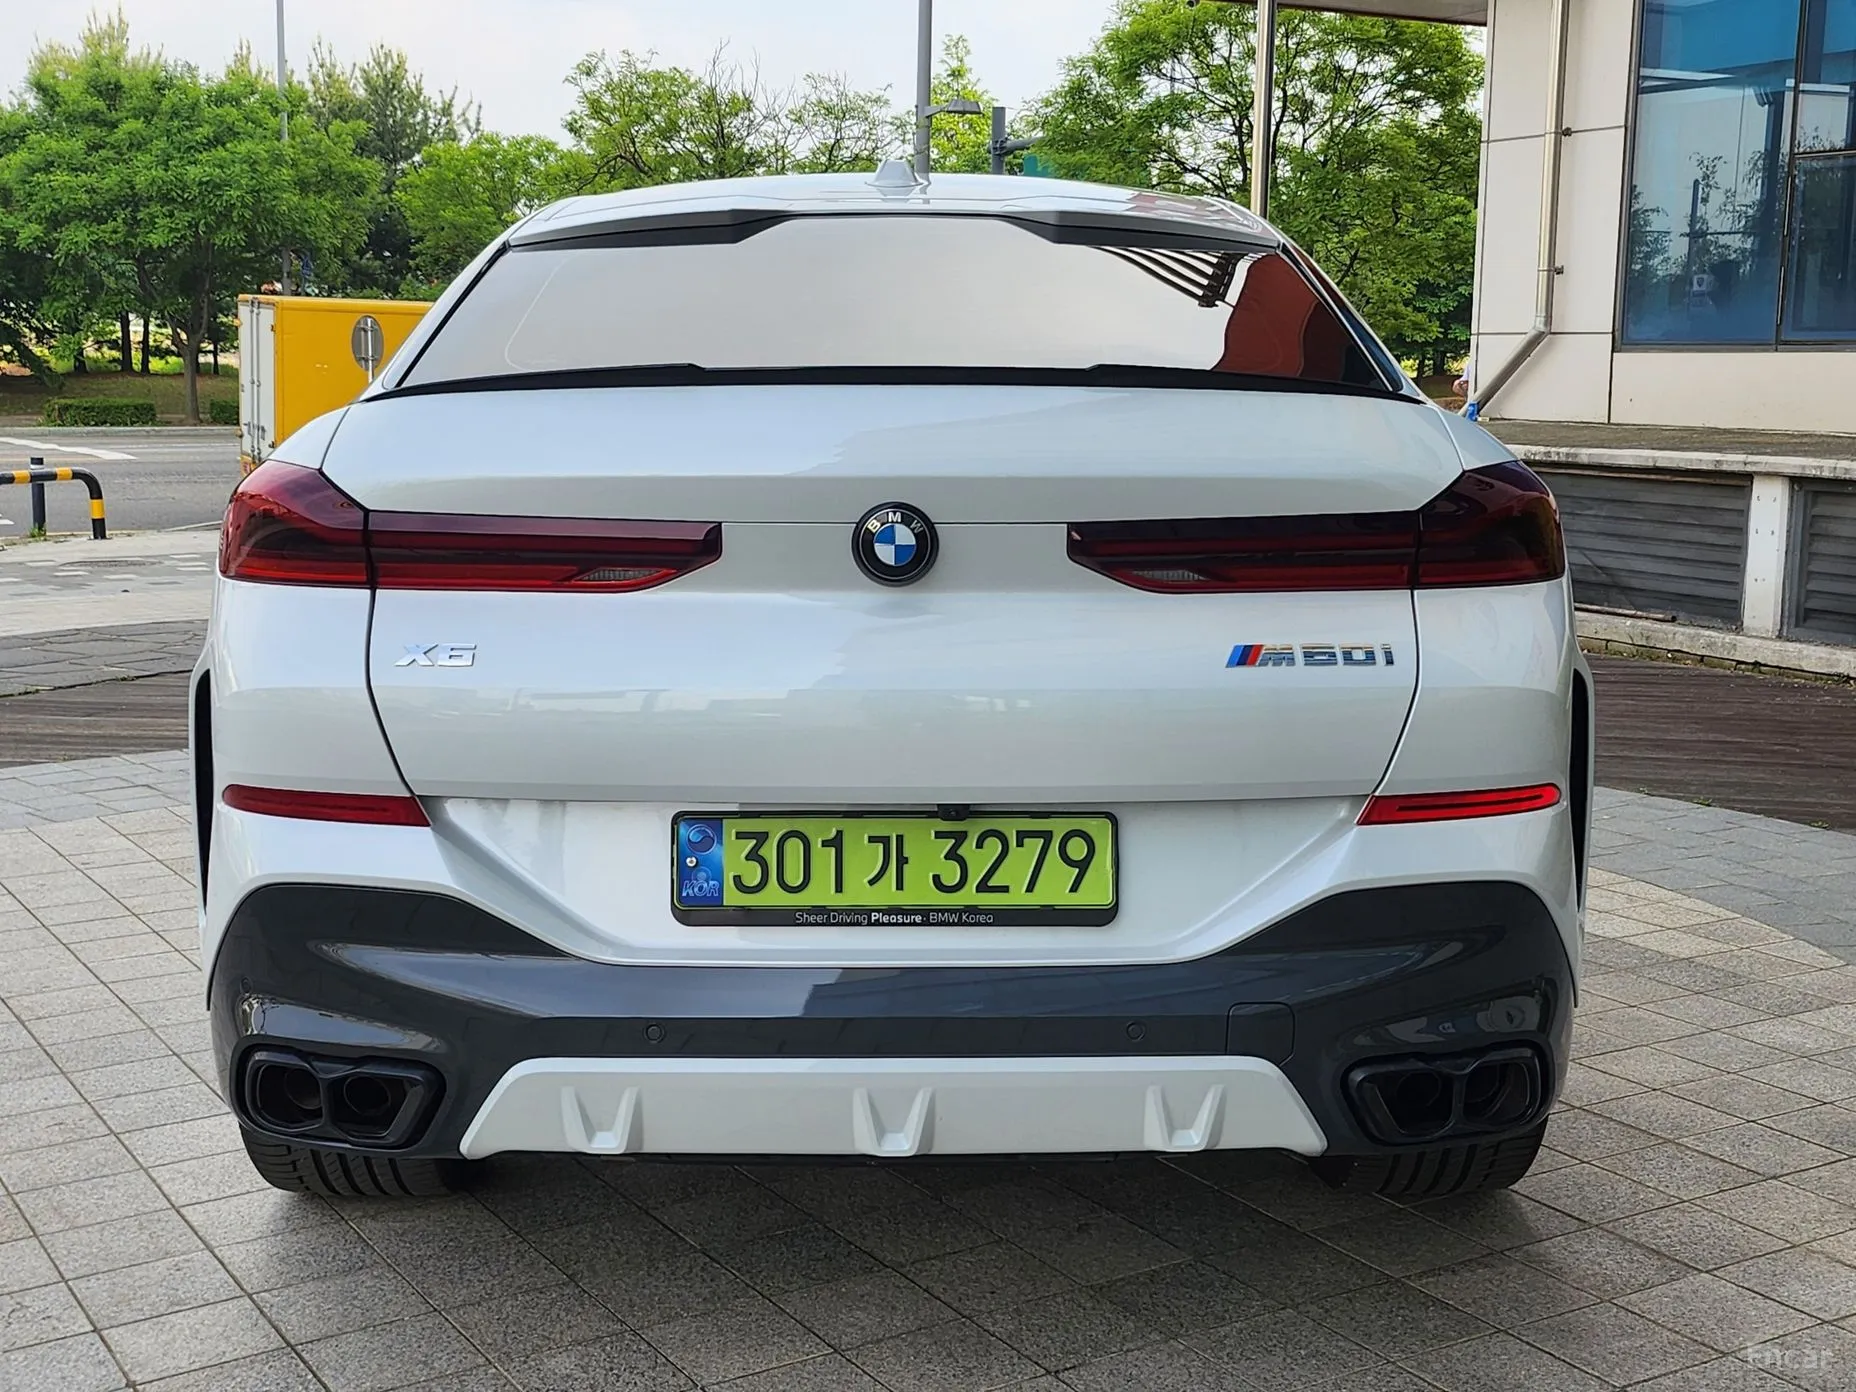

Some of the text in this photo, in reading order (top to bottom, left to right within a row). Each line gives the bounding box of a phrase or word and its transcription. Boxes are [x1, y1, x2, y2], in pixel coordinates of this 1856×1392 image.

[867, 511, 924, 534] BMW
[394, 643, 477, 668] X6
[682, 880, 720, 897] KOR
[795, 911, 828, 923] Sheer
[830, 911, 868, 926] Driving
[929, 912, 959, 923] BMW
[961, 912, 994, 924] Korea
